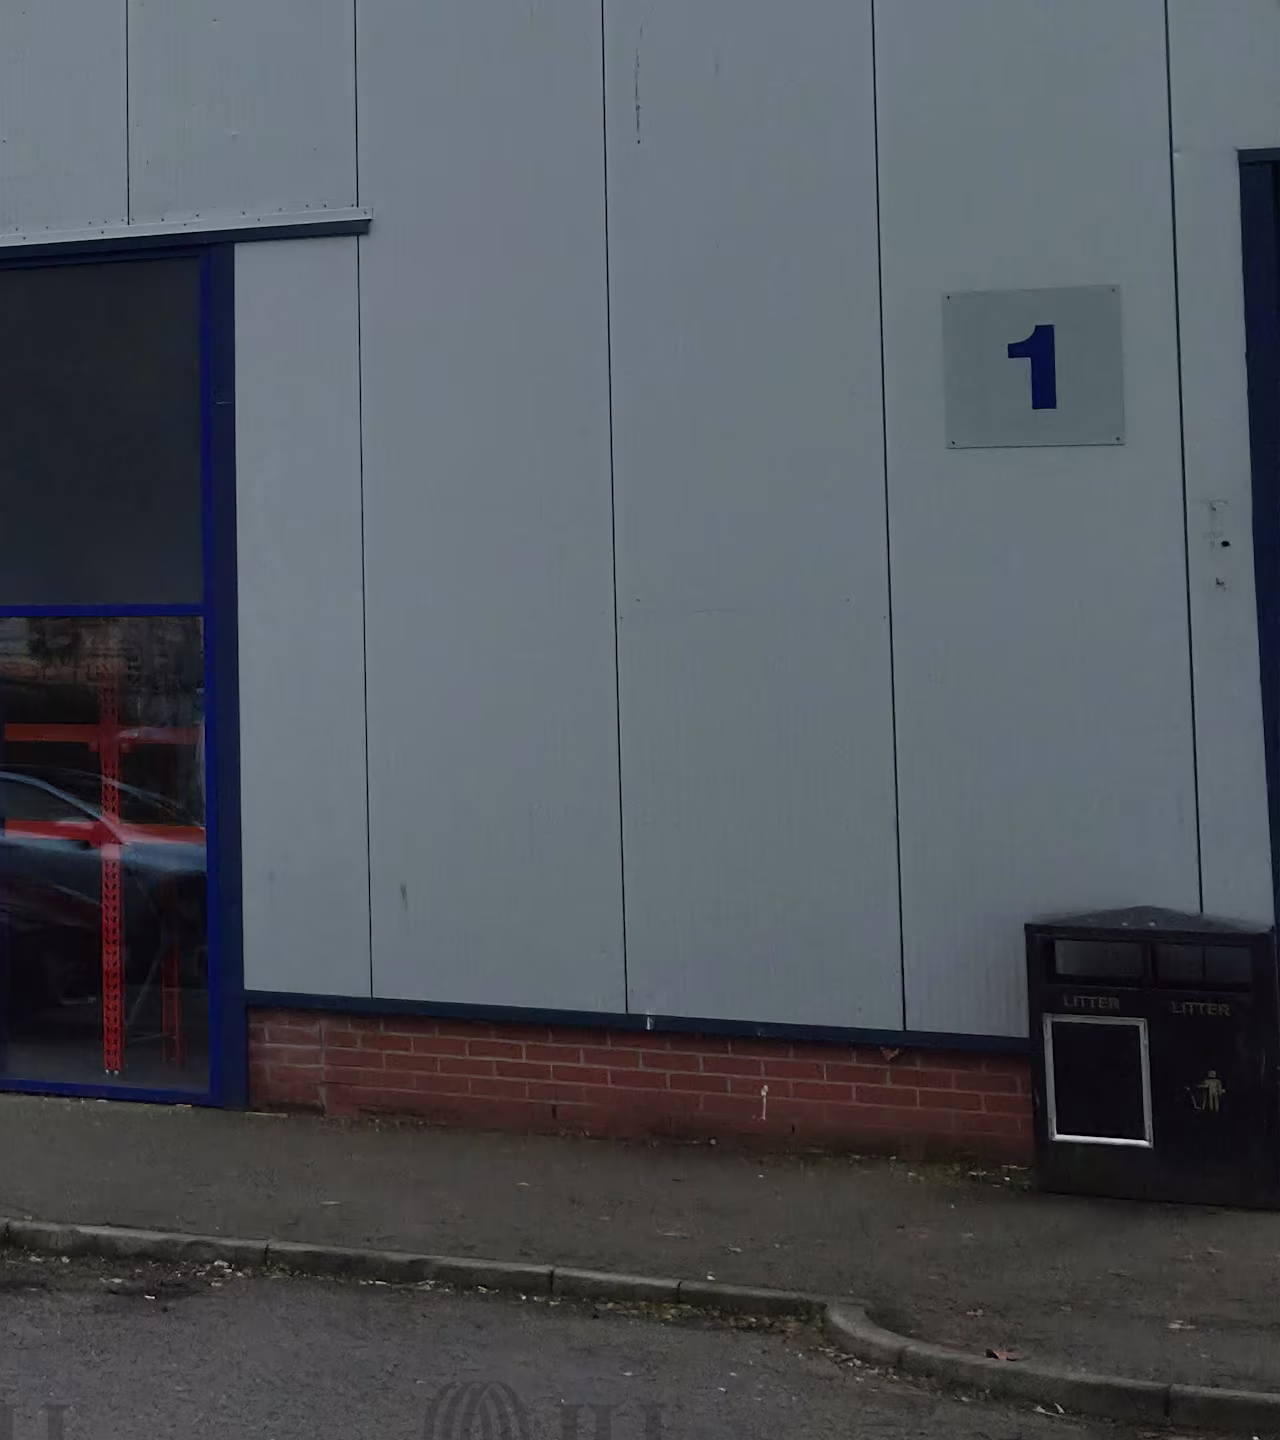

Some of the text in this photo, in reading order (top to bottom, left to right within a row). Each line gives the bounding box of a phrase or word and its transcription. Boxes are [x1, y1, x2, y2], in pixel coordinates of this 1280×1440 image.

[1007, 324, 1057, 409] 1
[1063, 995, 1121, 1010] LITTER
[1171, 1000, 1232, 1016] LITTER
